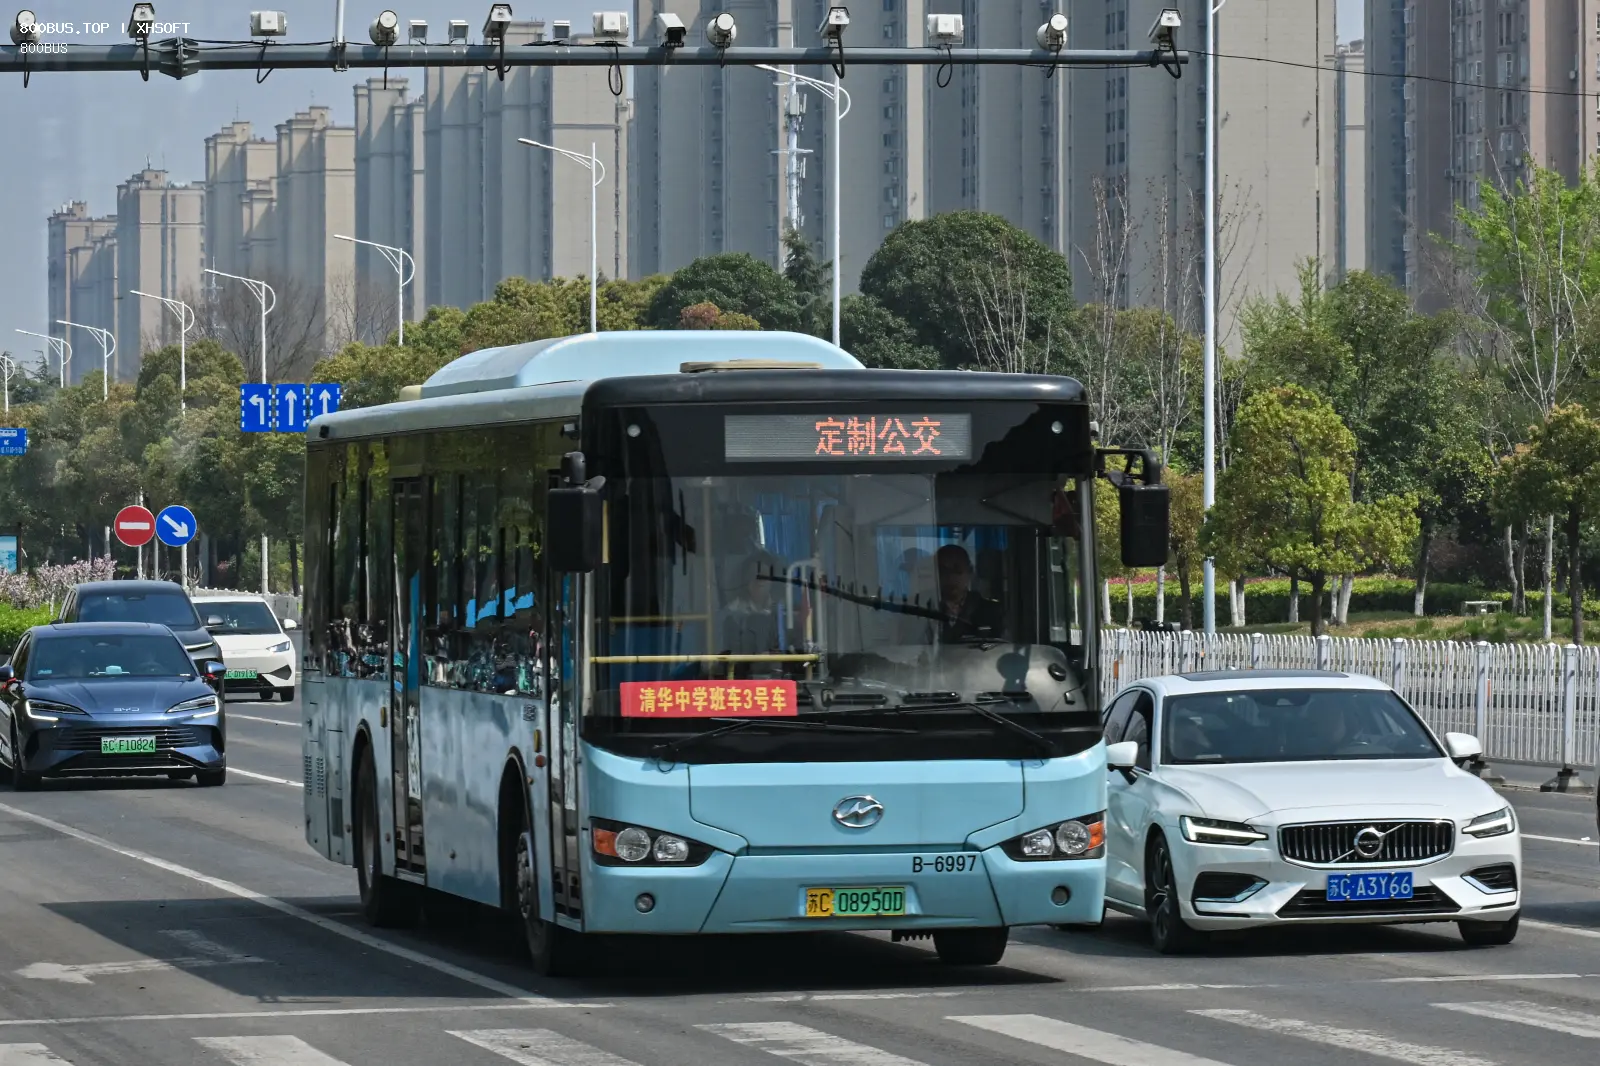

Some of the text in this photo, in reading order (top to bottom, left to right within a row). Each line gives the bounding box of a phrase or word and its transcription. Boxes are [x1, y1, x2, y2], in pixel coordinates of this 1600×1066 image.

[815, 416, 942, 456] 定制公交
[639, 686, 787, 713] 清华中学班车3号车
[912, 855, 977, 873] B-6997
